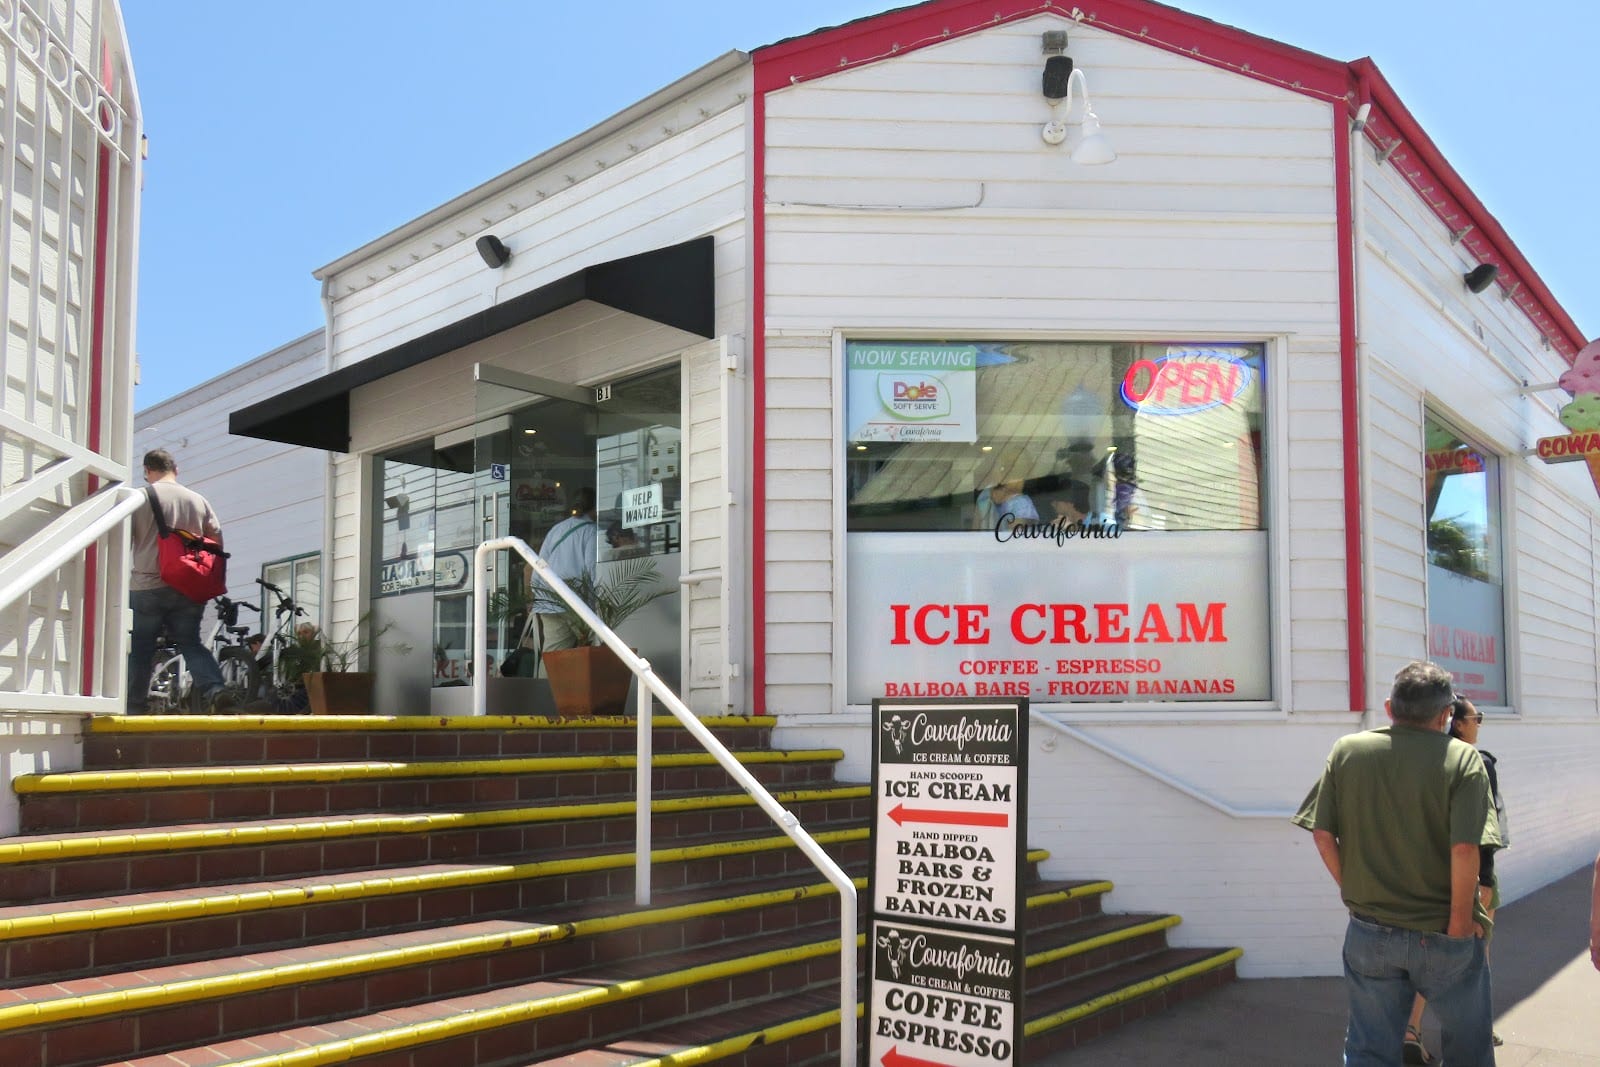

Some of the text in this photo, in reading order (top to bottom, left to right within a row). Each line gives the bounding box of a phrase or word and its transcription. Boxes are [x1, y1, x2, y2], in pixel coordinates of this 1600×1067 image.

[853, 350, 972, 366] NOW SERVING
[893, 382, 937, 400] Dole
[1124, 359, 1239, 404] OPEN
[1538, 433, 1600, 457] COWA
[632, 490, 653, 507] HELP
[625, 505, 658, 524] WANTED
[994, 512, 1123, 548] Cowafornia
[890, 603, 1227, 645] ICE CREAM
[1453, 628, 1497, 665] CREAM
[959, 660, 1039, 675] COFFEE
[1056, 658, 1161, 674] ESPRESSO
[884, 682, 968, 697] BALBOA
[975, 681, 1031, 697] BARS
[1047, 680, 1129, 696] FROZEN
[1135, 679, 1235, 695] BANANAS
[910, 712, 1013, 751] Cowafornia
[912, 752, 1010, 764] ICE CREAM & COFFEE
[910, 771, 984, 781] HAND SCOOPED
[885, 780, 1012, 802] ICE CREAM
[912, 831, 978, 843] HAND DIPPED
[896, 840, 995, 862] BALBOA
[898, 859, 993, 882] BARS &
[896, 878, 994, 902] FROZEN
[885, 896, 1007, 924] BANANAS
[909, 934, 1014, 979] Cowafornia
[911, 974, 1011, 1000] ICE CREAM & COFFEE
[885, 988, 1002, 1031] COFFEE
[876, 1016, 1011, 1061] ESPRESSO
